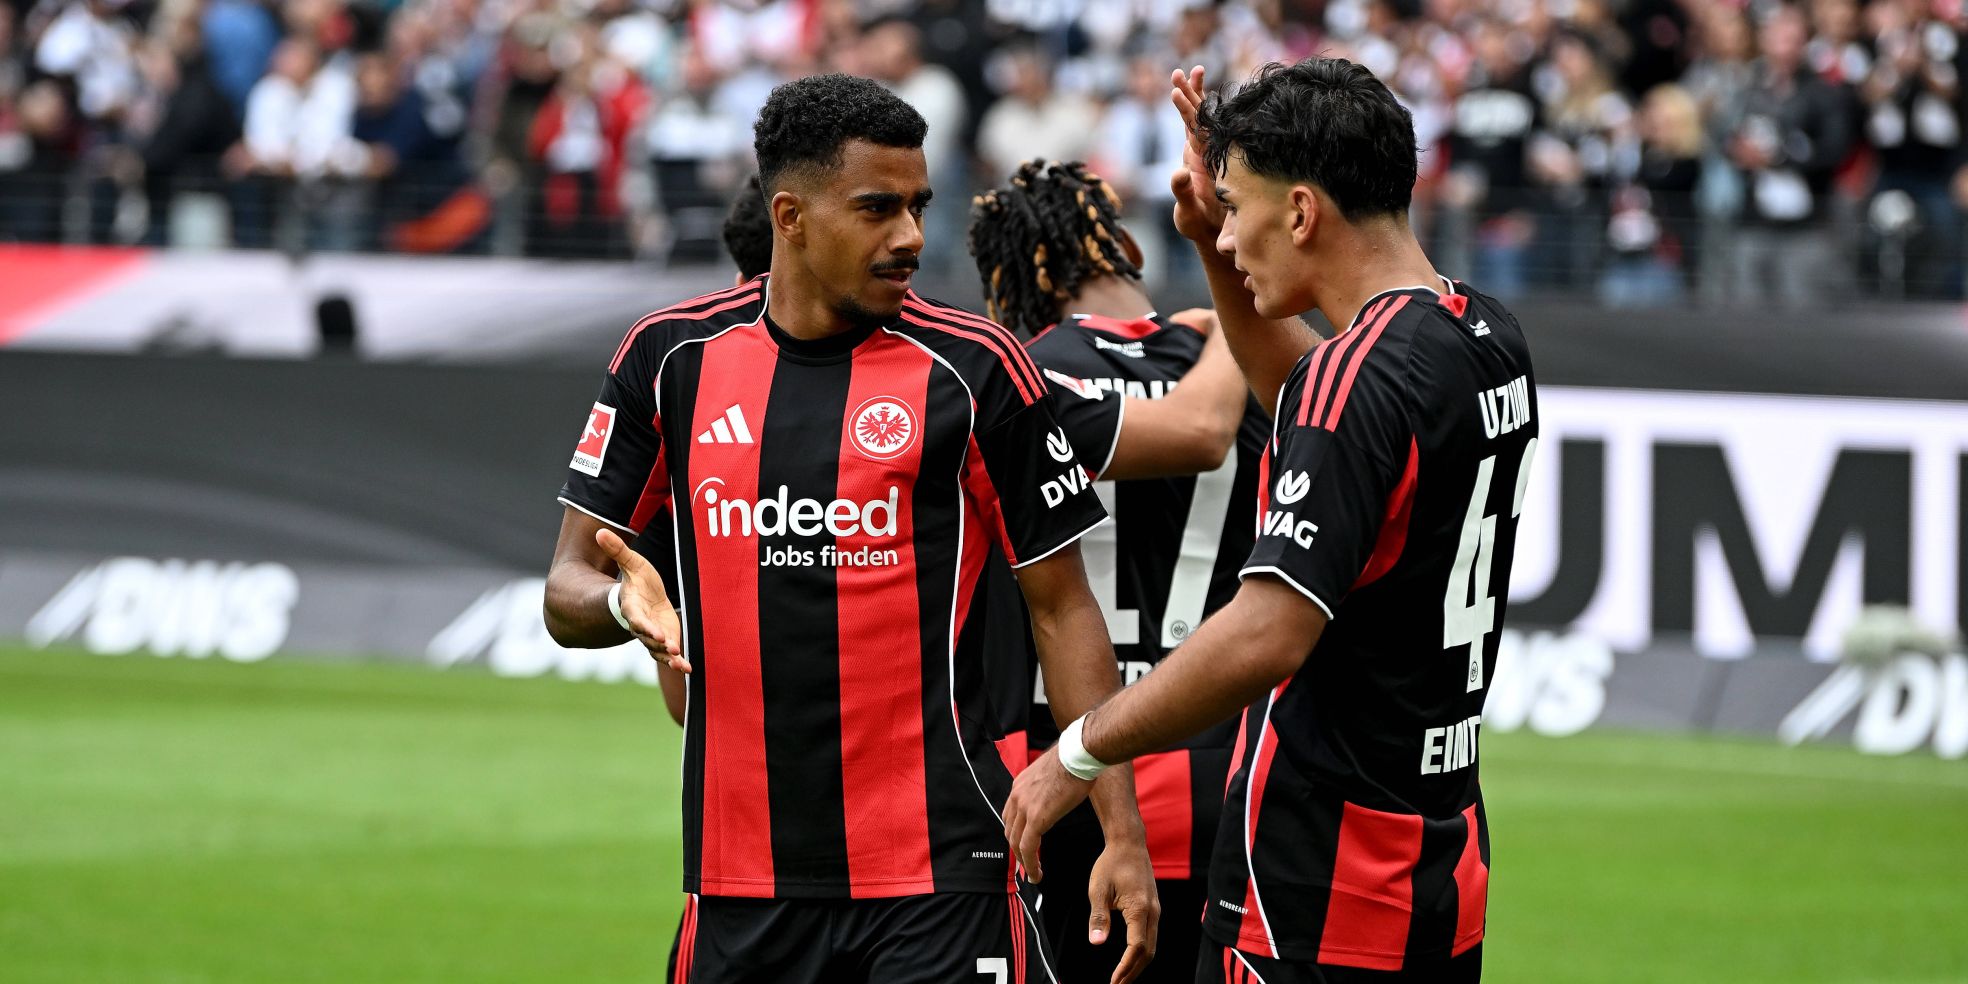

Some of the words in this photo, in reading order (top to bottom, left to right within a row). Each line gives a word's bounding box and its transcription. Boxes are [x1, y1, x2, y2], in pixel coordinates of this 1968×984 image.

[1478, 374, 1531, 439] UZUN
[702, 484, 898, 537] indeed
[1263, 510, 1319, 550] VAG
[760, 545, 815, 567] Jobs
[819, 545, 898, 567] finden
